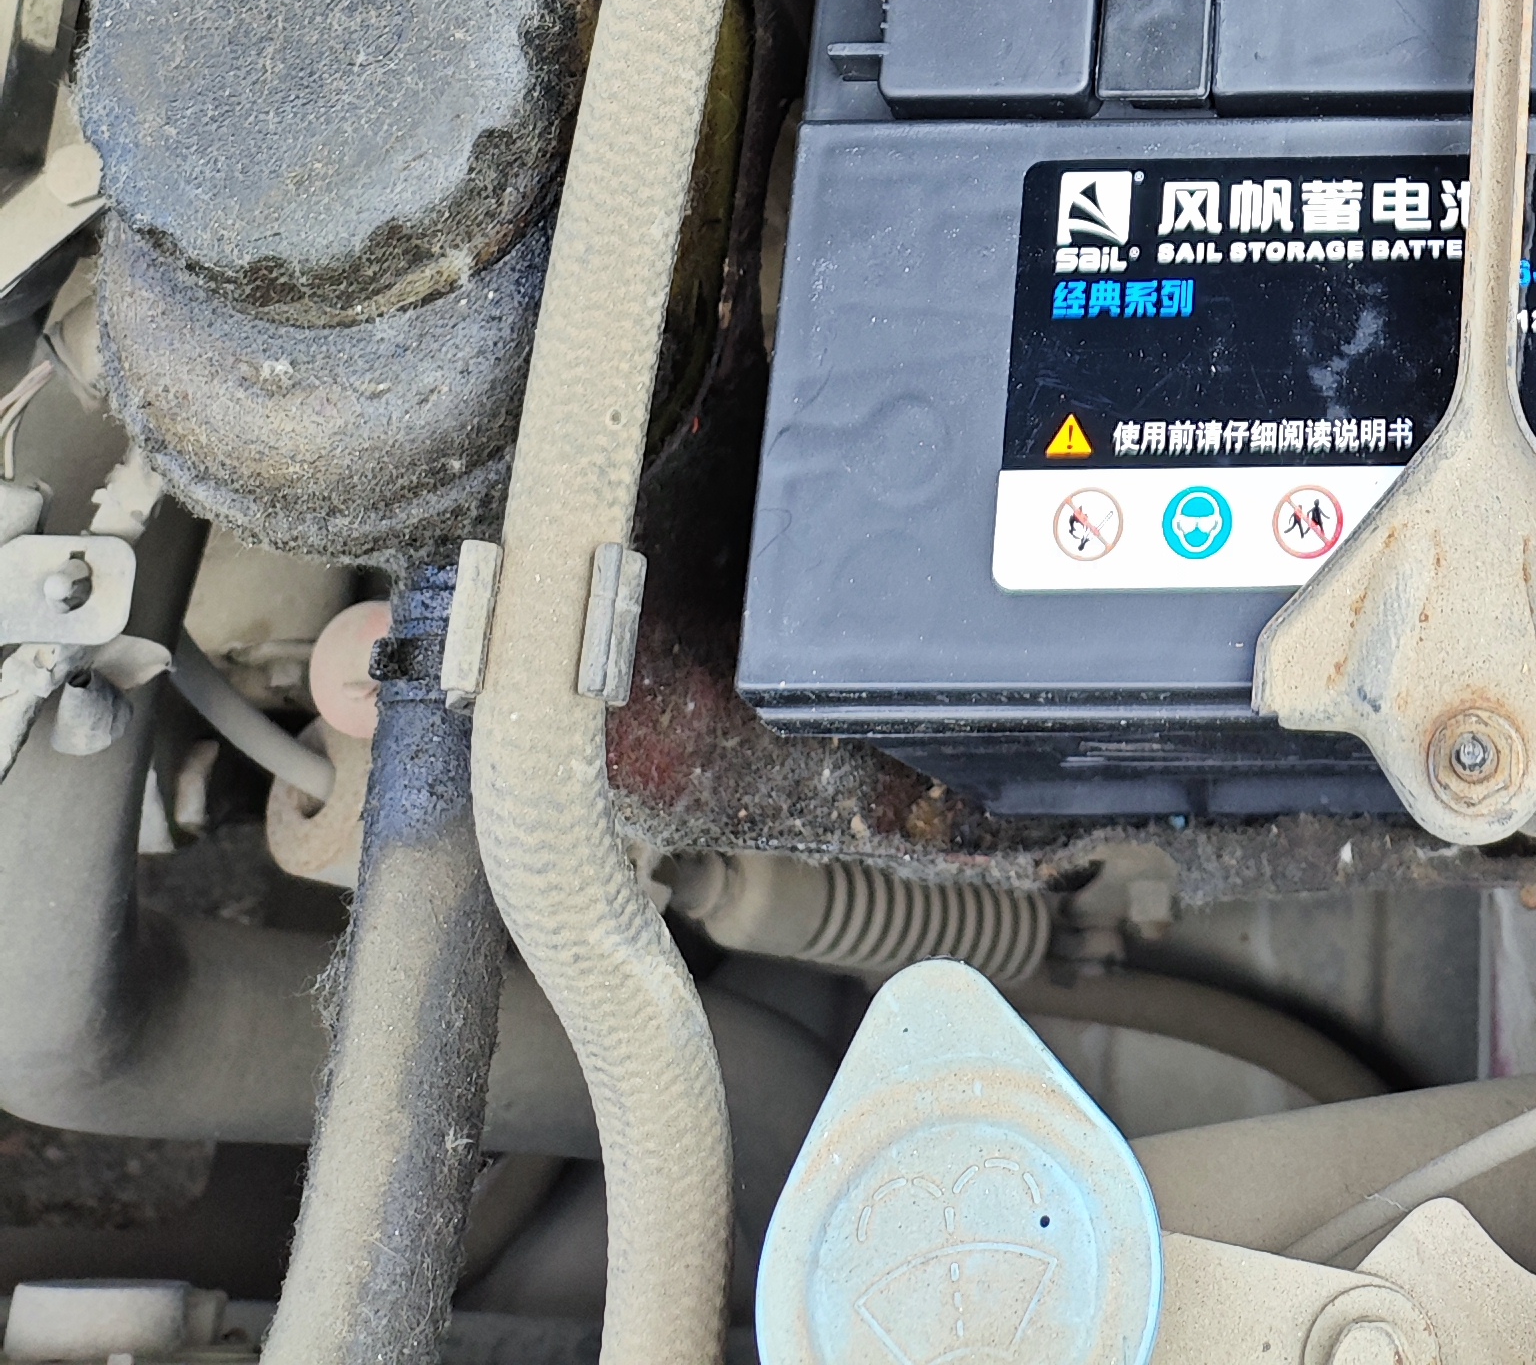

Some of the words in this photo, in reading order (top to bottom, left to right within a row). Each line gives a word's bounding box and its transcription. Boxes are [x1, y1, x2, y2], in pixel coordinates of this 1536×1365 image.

[1157, 241, 1223, 265] SAIL
[1229, 240, 1365, 264] STORAGE
[1371, 238, 1464, 262] BATTE
[1051, 279, 1196, 320] 经典系列
[1111, 417, 1414, 456] 使用前请仔细阅读说明书
